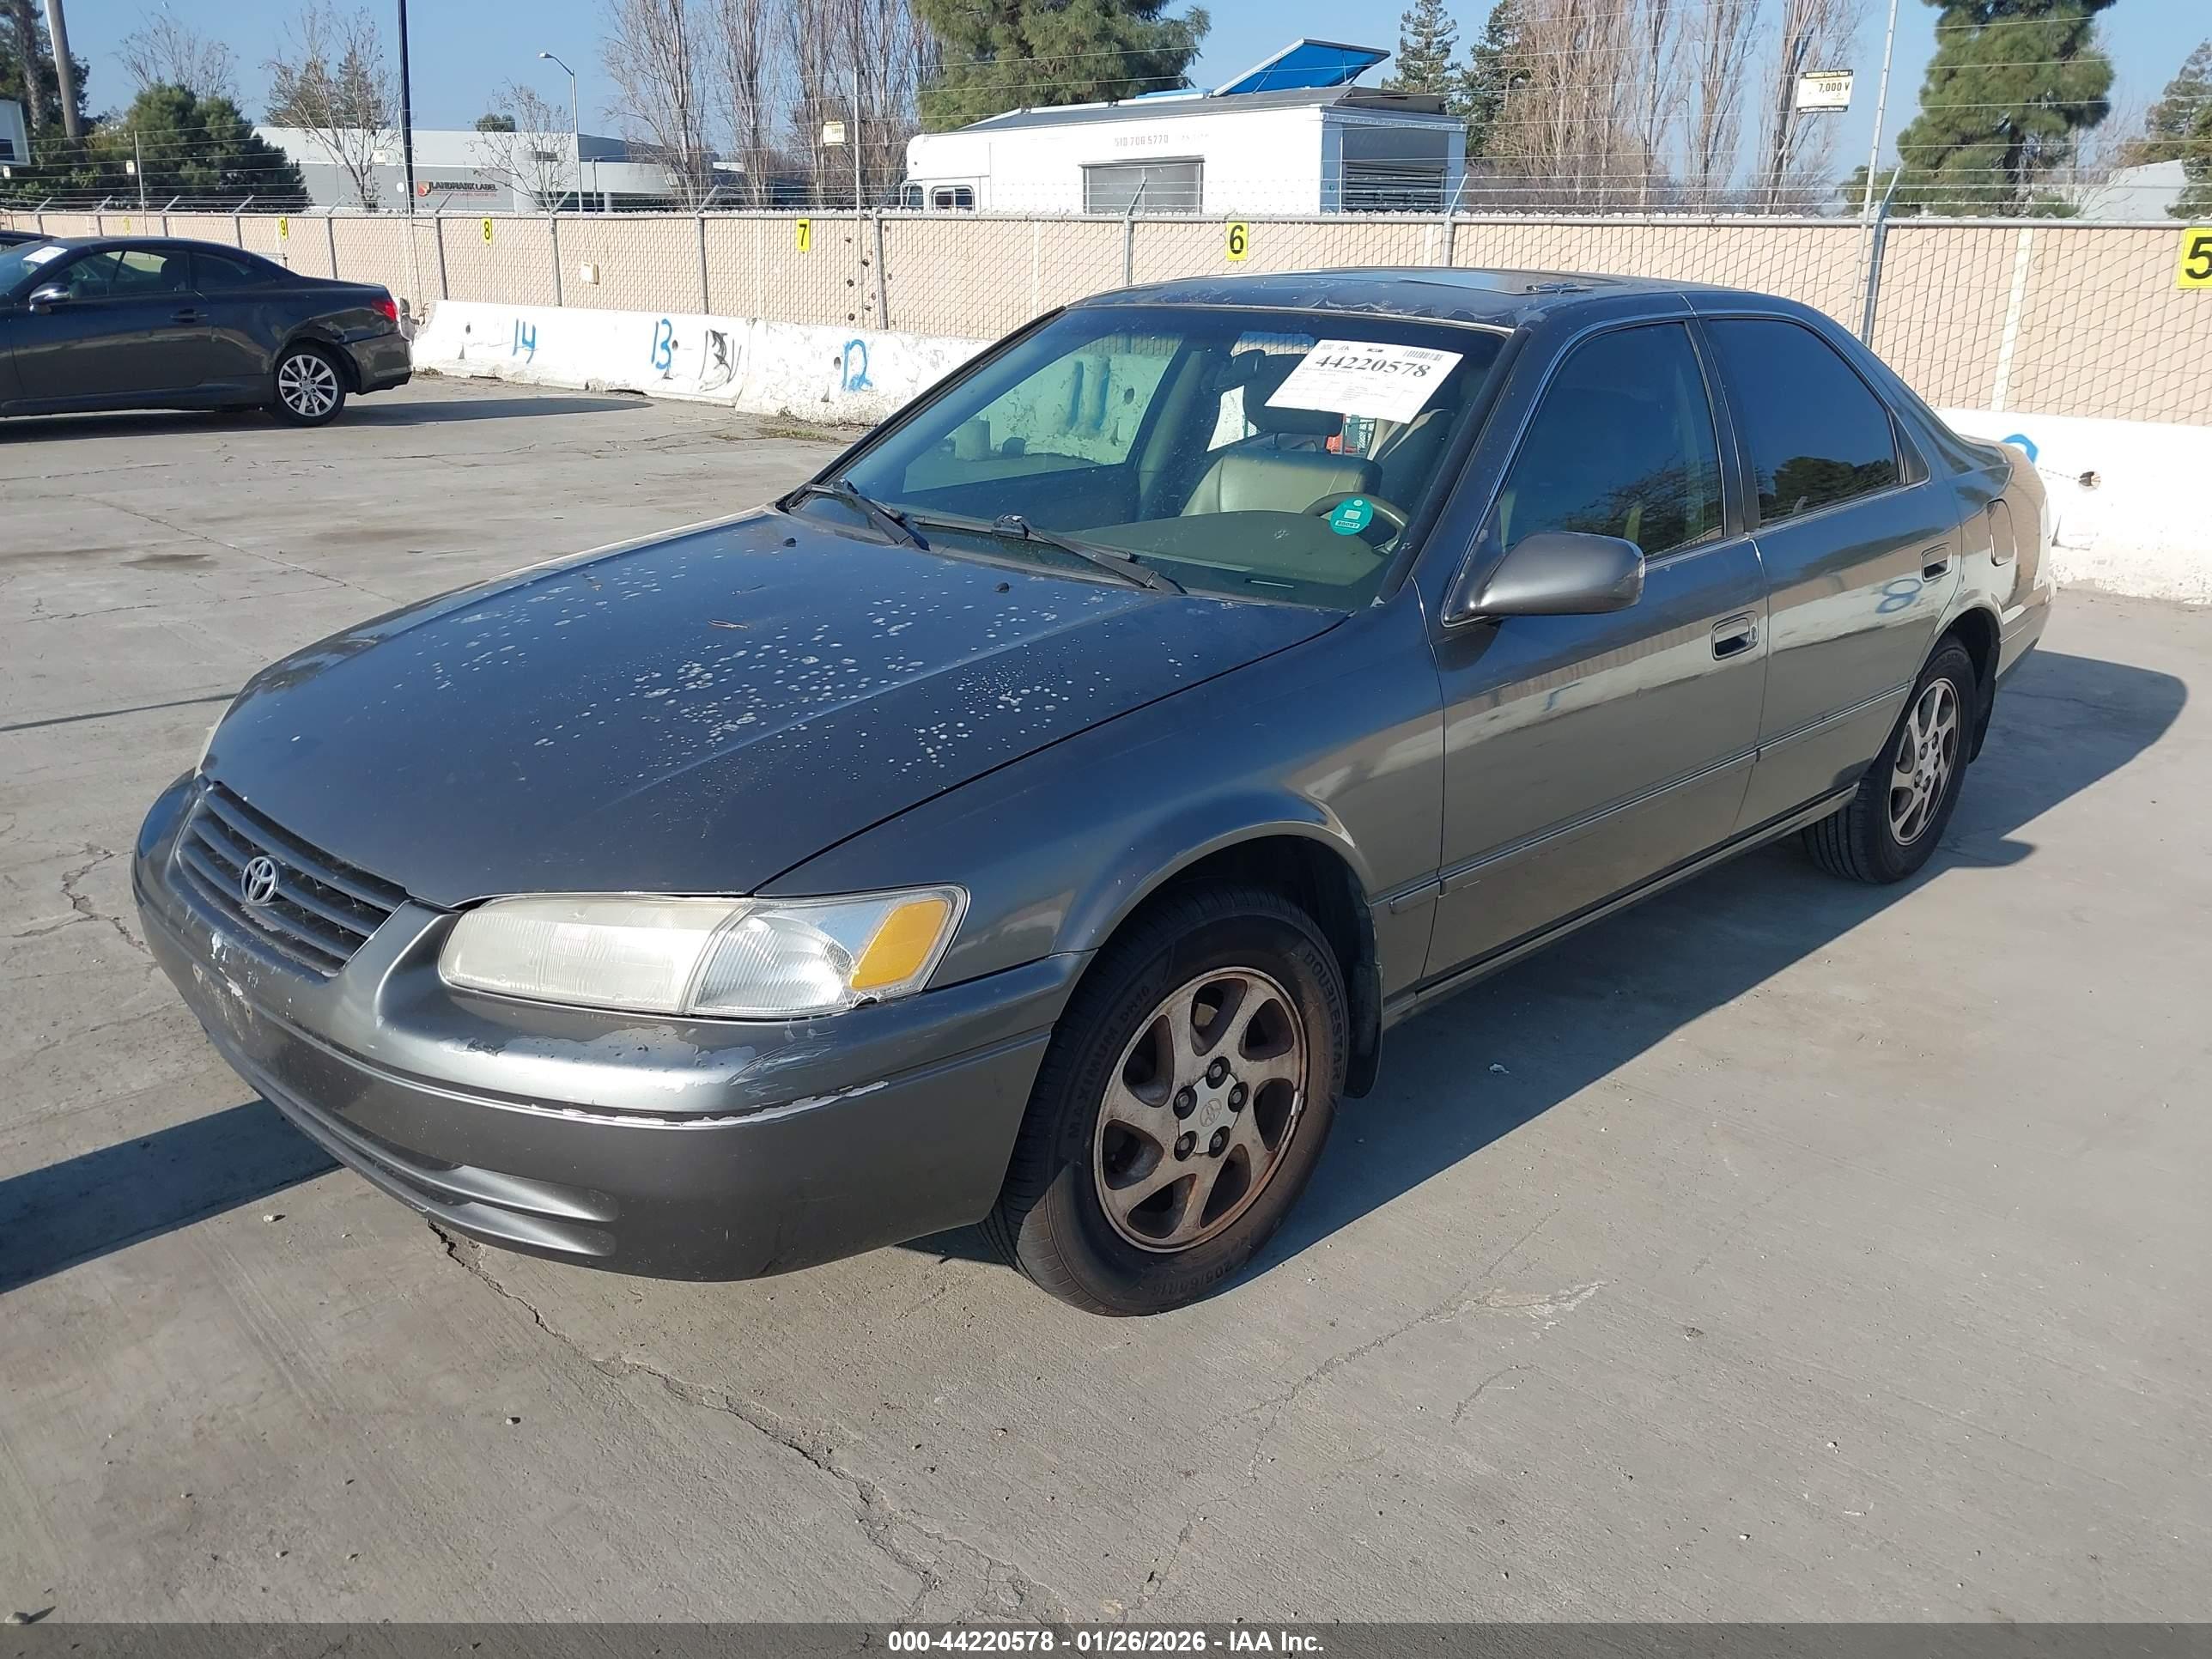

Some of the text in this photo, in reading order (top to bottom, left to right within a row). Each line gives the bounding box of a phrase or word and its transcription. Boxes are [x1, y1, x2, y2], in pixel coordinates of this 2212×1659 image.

[1818, 82, 1851, 94] 7,000 V
[799, 223, 808, 247] 7
[1229, 224, 1244, 255] 6
[2185, 236, 2212, 280] 5
[512, 318, 538, 364] 14
[650, 318, 673, 371] 13
[842, 338, 873, 392] 12
[1315, 354, 1431, 378] 44220578
[1304, 950, 1345, 1079] DOUBLESTAR
[1067, 1026, 1119, 1139] MAXIMUM
